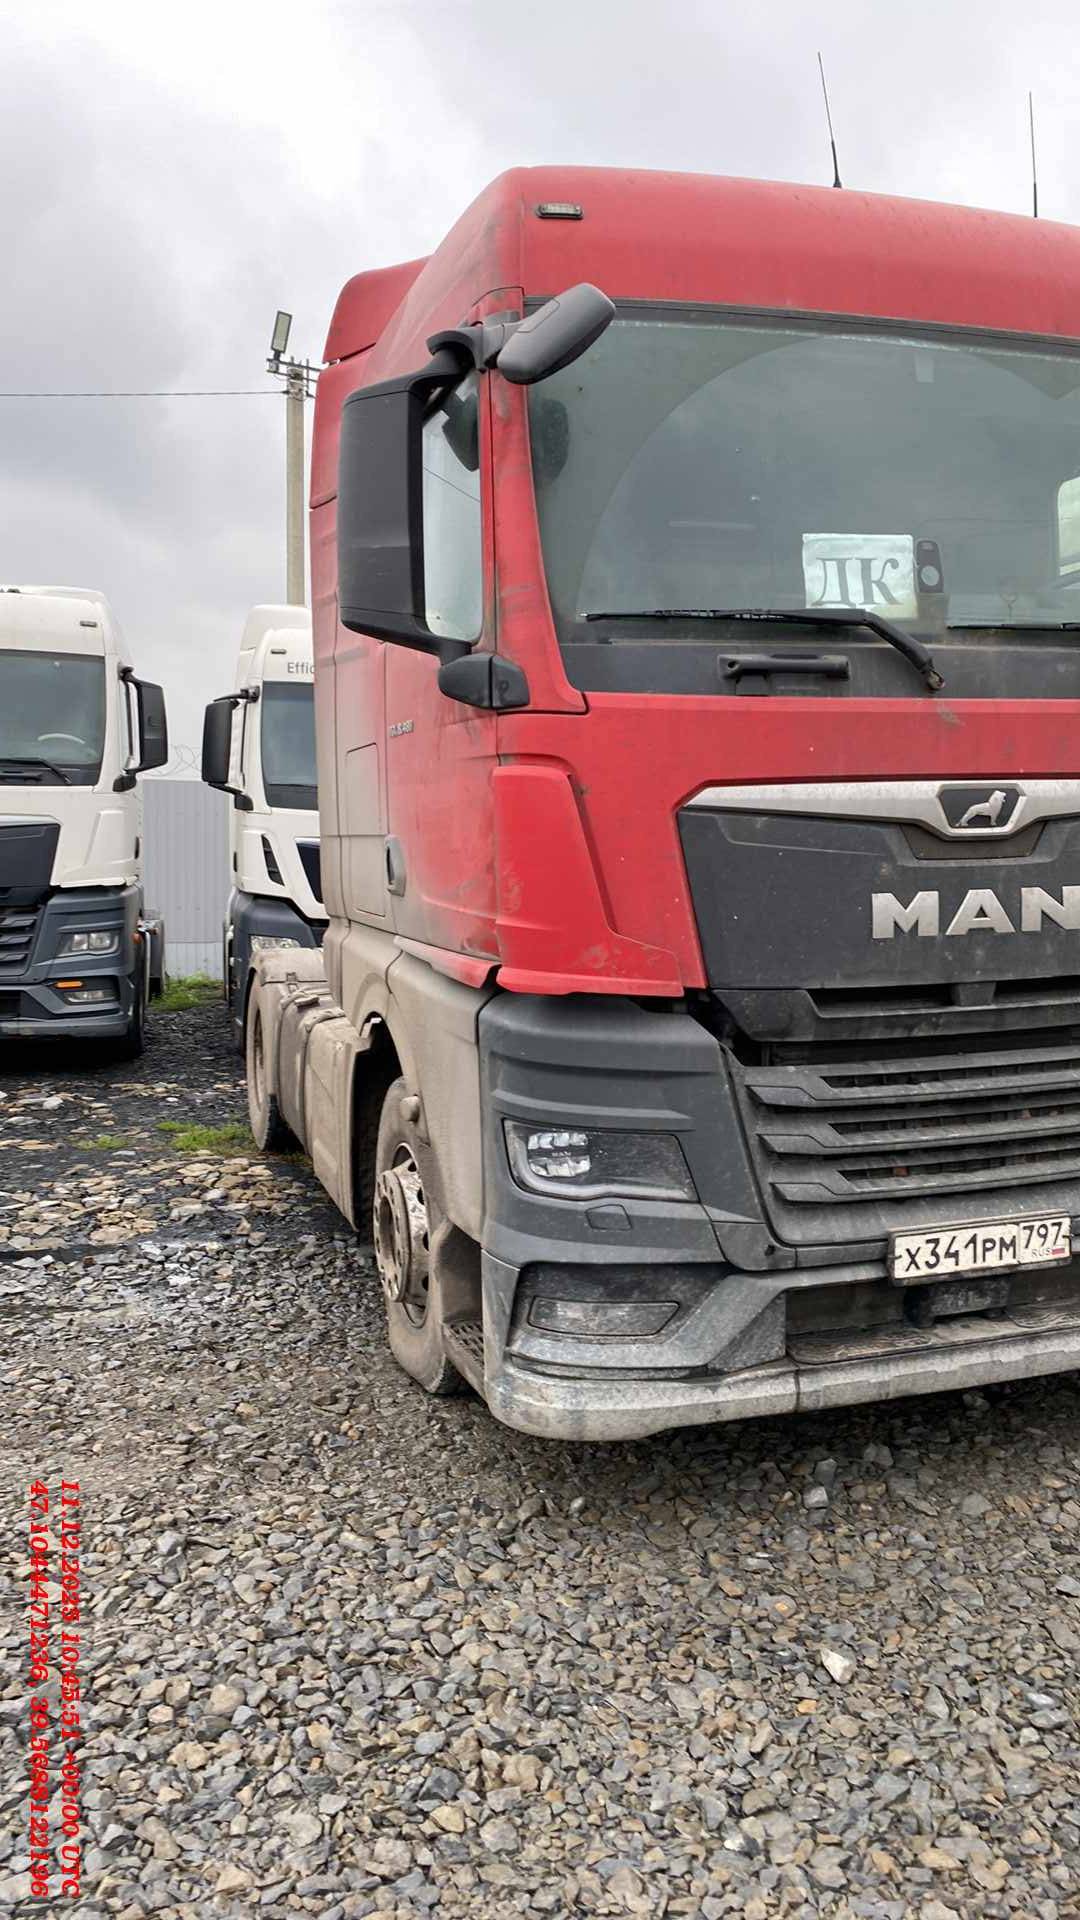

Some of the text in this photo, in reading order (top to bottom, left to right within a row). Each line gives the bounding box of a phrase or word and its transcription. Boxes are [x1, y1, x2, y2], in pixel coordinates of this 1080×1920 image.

[811, 556, 903, 607] ДК
[871, 885, 1080, 939] MAN
[1022, 1221, 1064, 1249] 797
[1031, 1248, 1051, 1258] RUS
